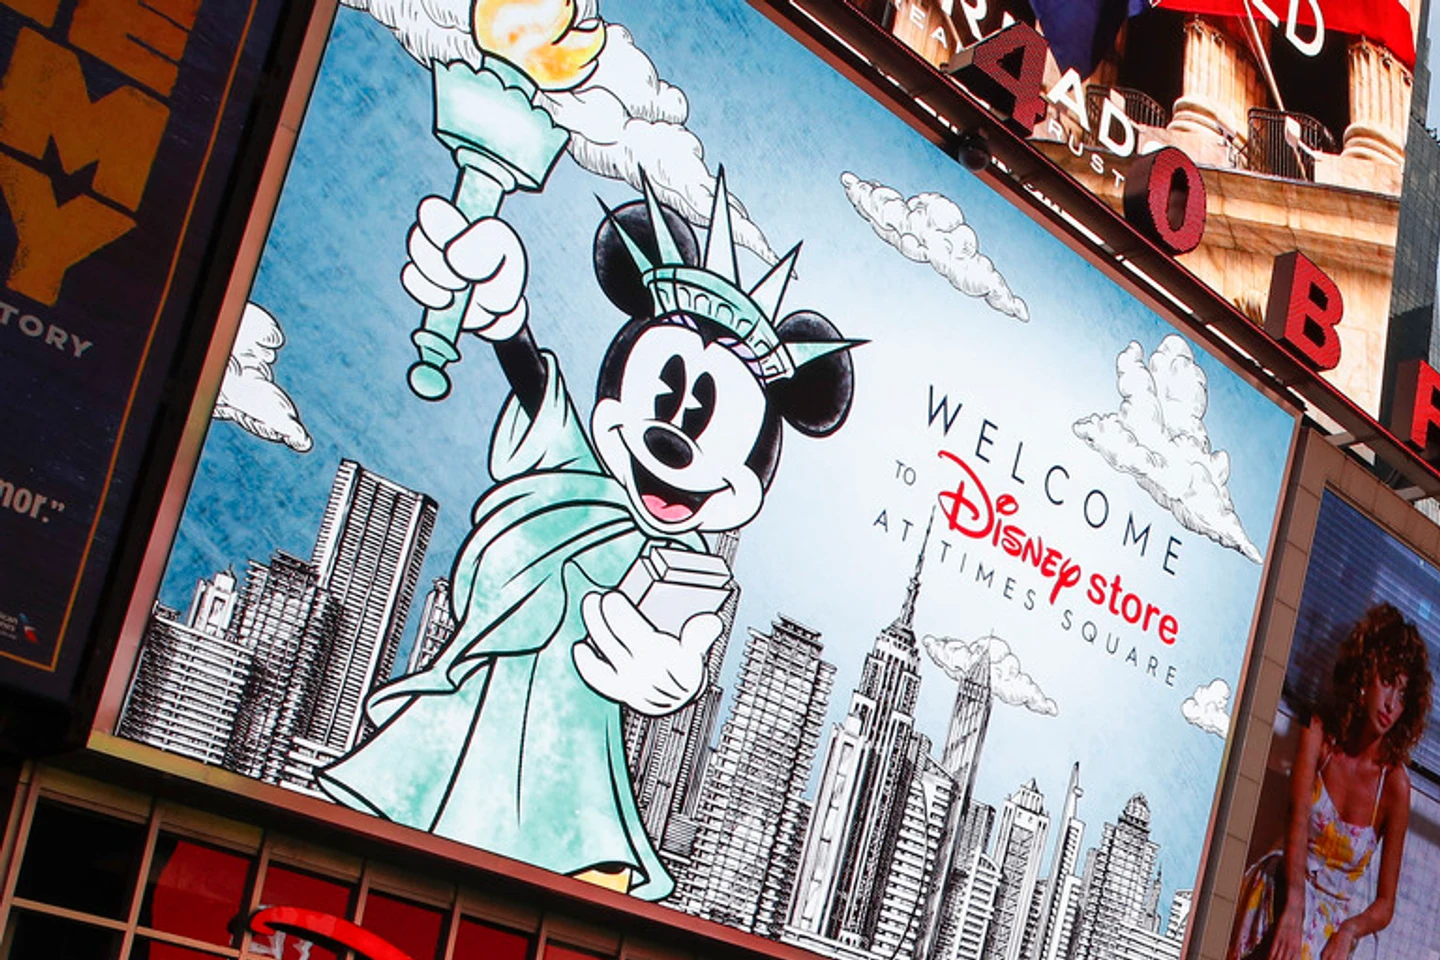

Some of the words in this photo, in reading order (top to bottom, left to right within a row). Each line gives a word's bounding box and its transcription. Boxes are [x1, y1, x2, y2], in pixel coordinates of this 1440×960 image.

[894, 460, 917, 486] TO
[1086, 573, 1179, 645] store
[926, 384, 1183, 576] WELCOME
[873, 509, 914, 542] AT
[940, 540, 1037, 612] TIMES
[1060, 608, 1178, 688] SQUARE
